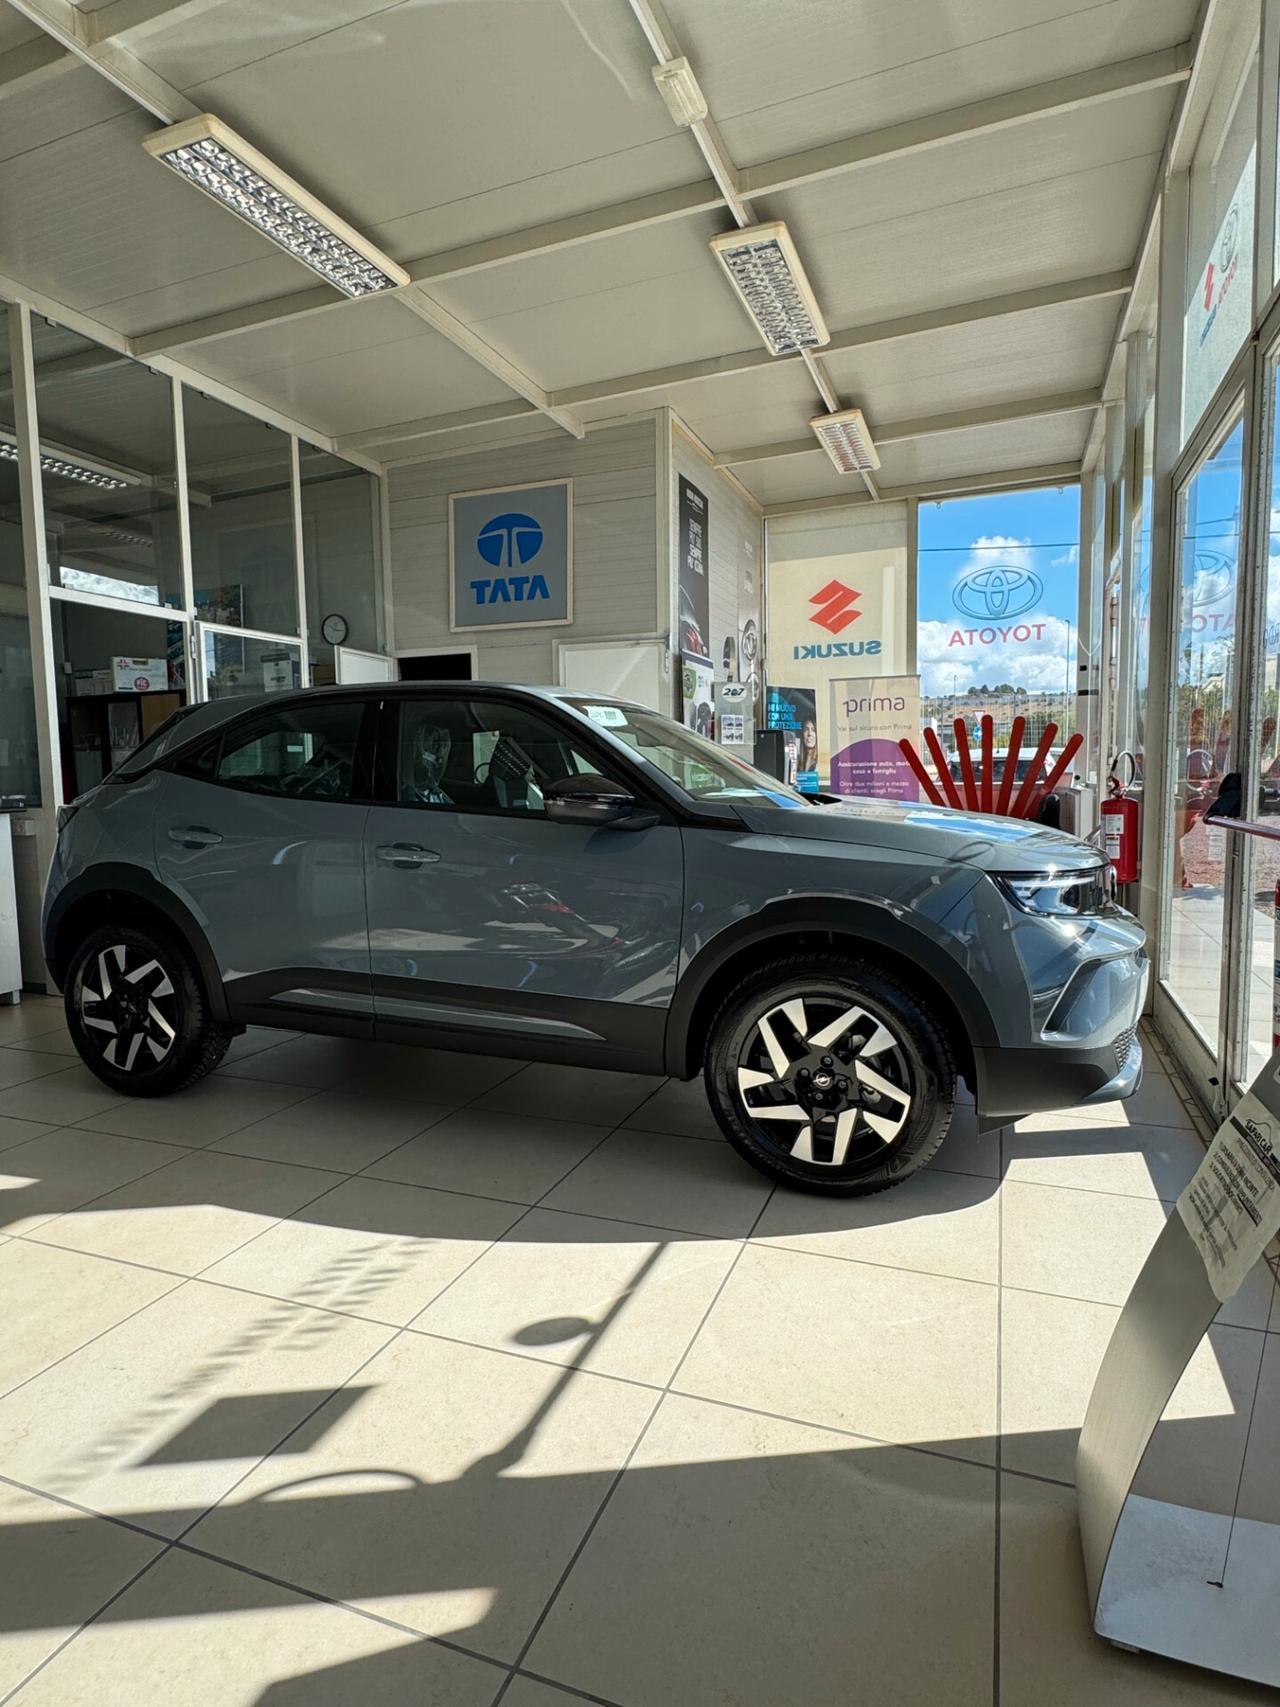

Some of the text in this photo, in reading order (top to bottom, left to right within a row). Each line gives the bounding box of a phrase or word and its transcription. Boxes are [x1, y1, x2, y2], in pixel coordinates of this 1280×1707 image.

[470, 575, 550, 605] TATA
[842, 696, 905, 718] prima
[768, 721, 803, 730] PROTEZIONE
[872, 767, 896, 775] famiglia
[1245, 1120, 1263, 1143] SAFARI
[1259, 1138, 1273, 1154] CAR
